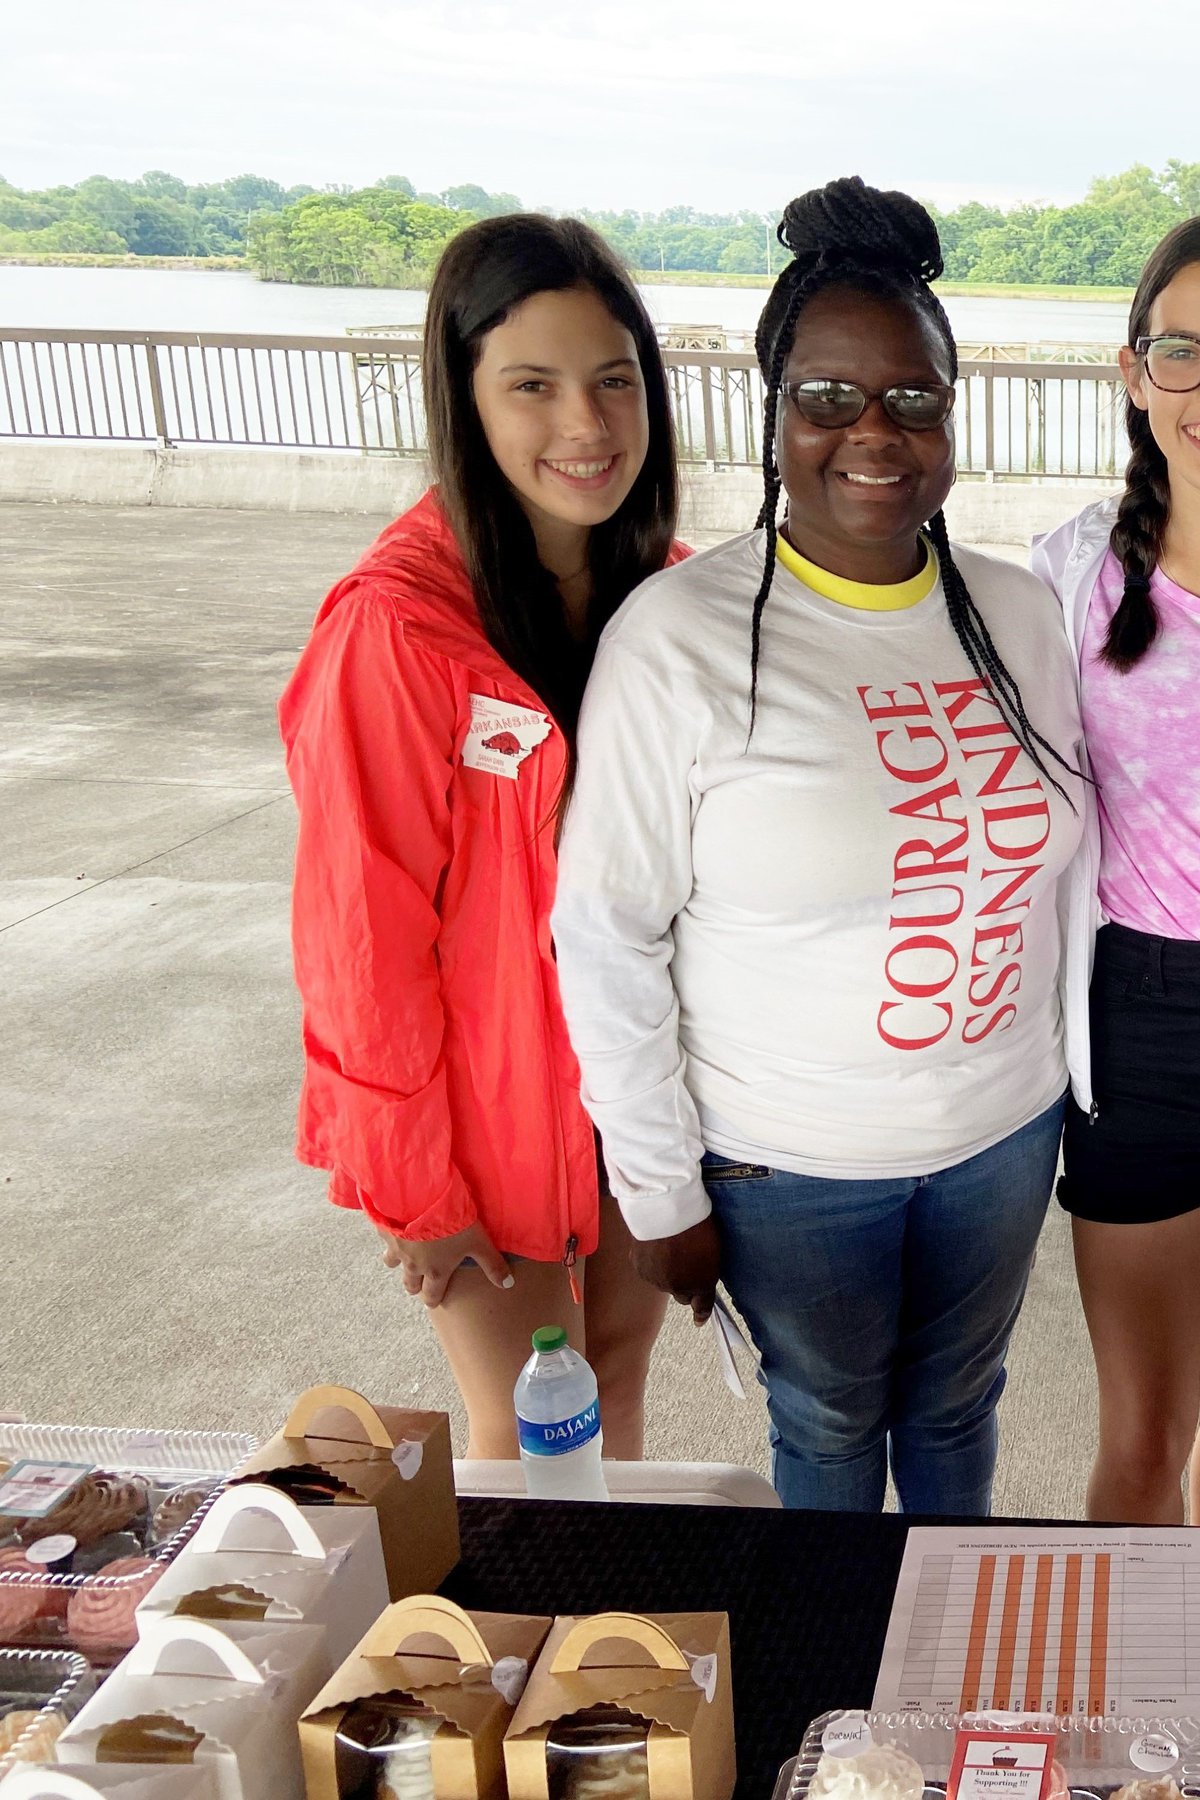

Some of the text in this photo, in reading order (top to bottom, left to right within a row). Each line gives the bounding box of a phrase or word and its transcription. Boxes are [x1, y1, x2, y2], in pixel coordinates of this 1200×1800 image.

[857, 682, 969, 1050] COURAGE
[932, 673, 1051, 1044] KINDNESS
[544, 1407, 596, 1441] DASANI
[974, 1779, 1018, 1788] Supporting
[976, 1769, 999, 1778] Thank
[1003, 1770, 1017, 1778] You
